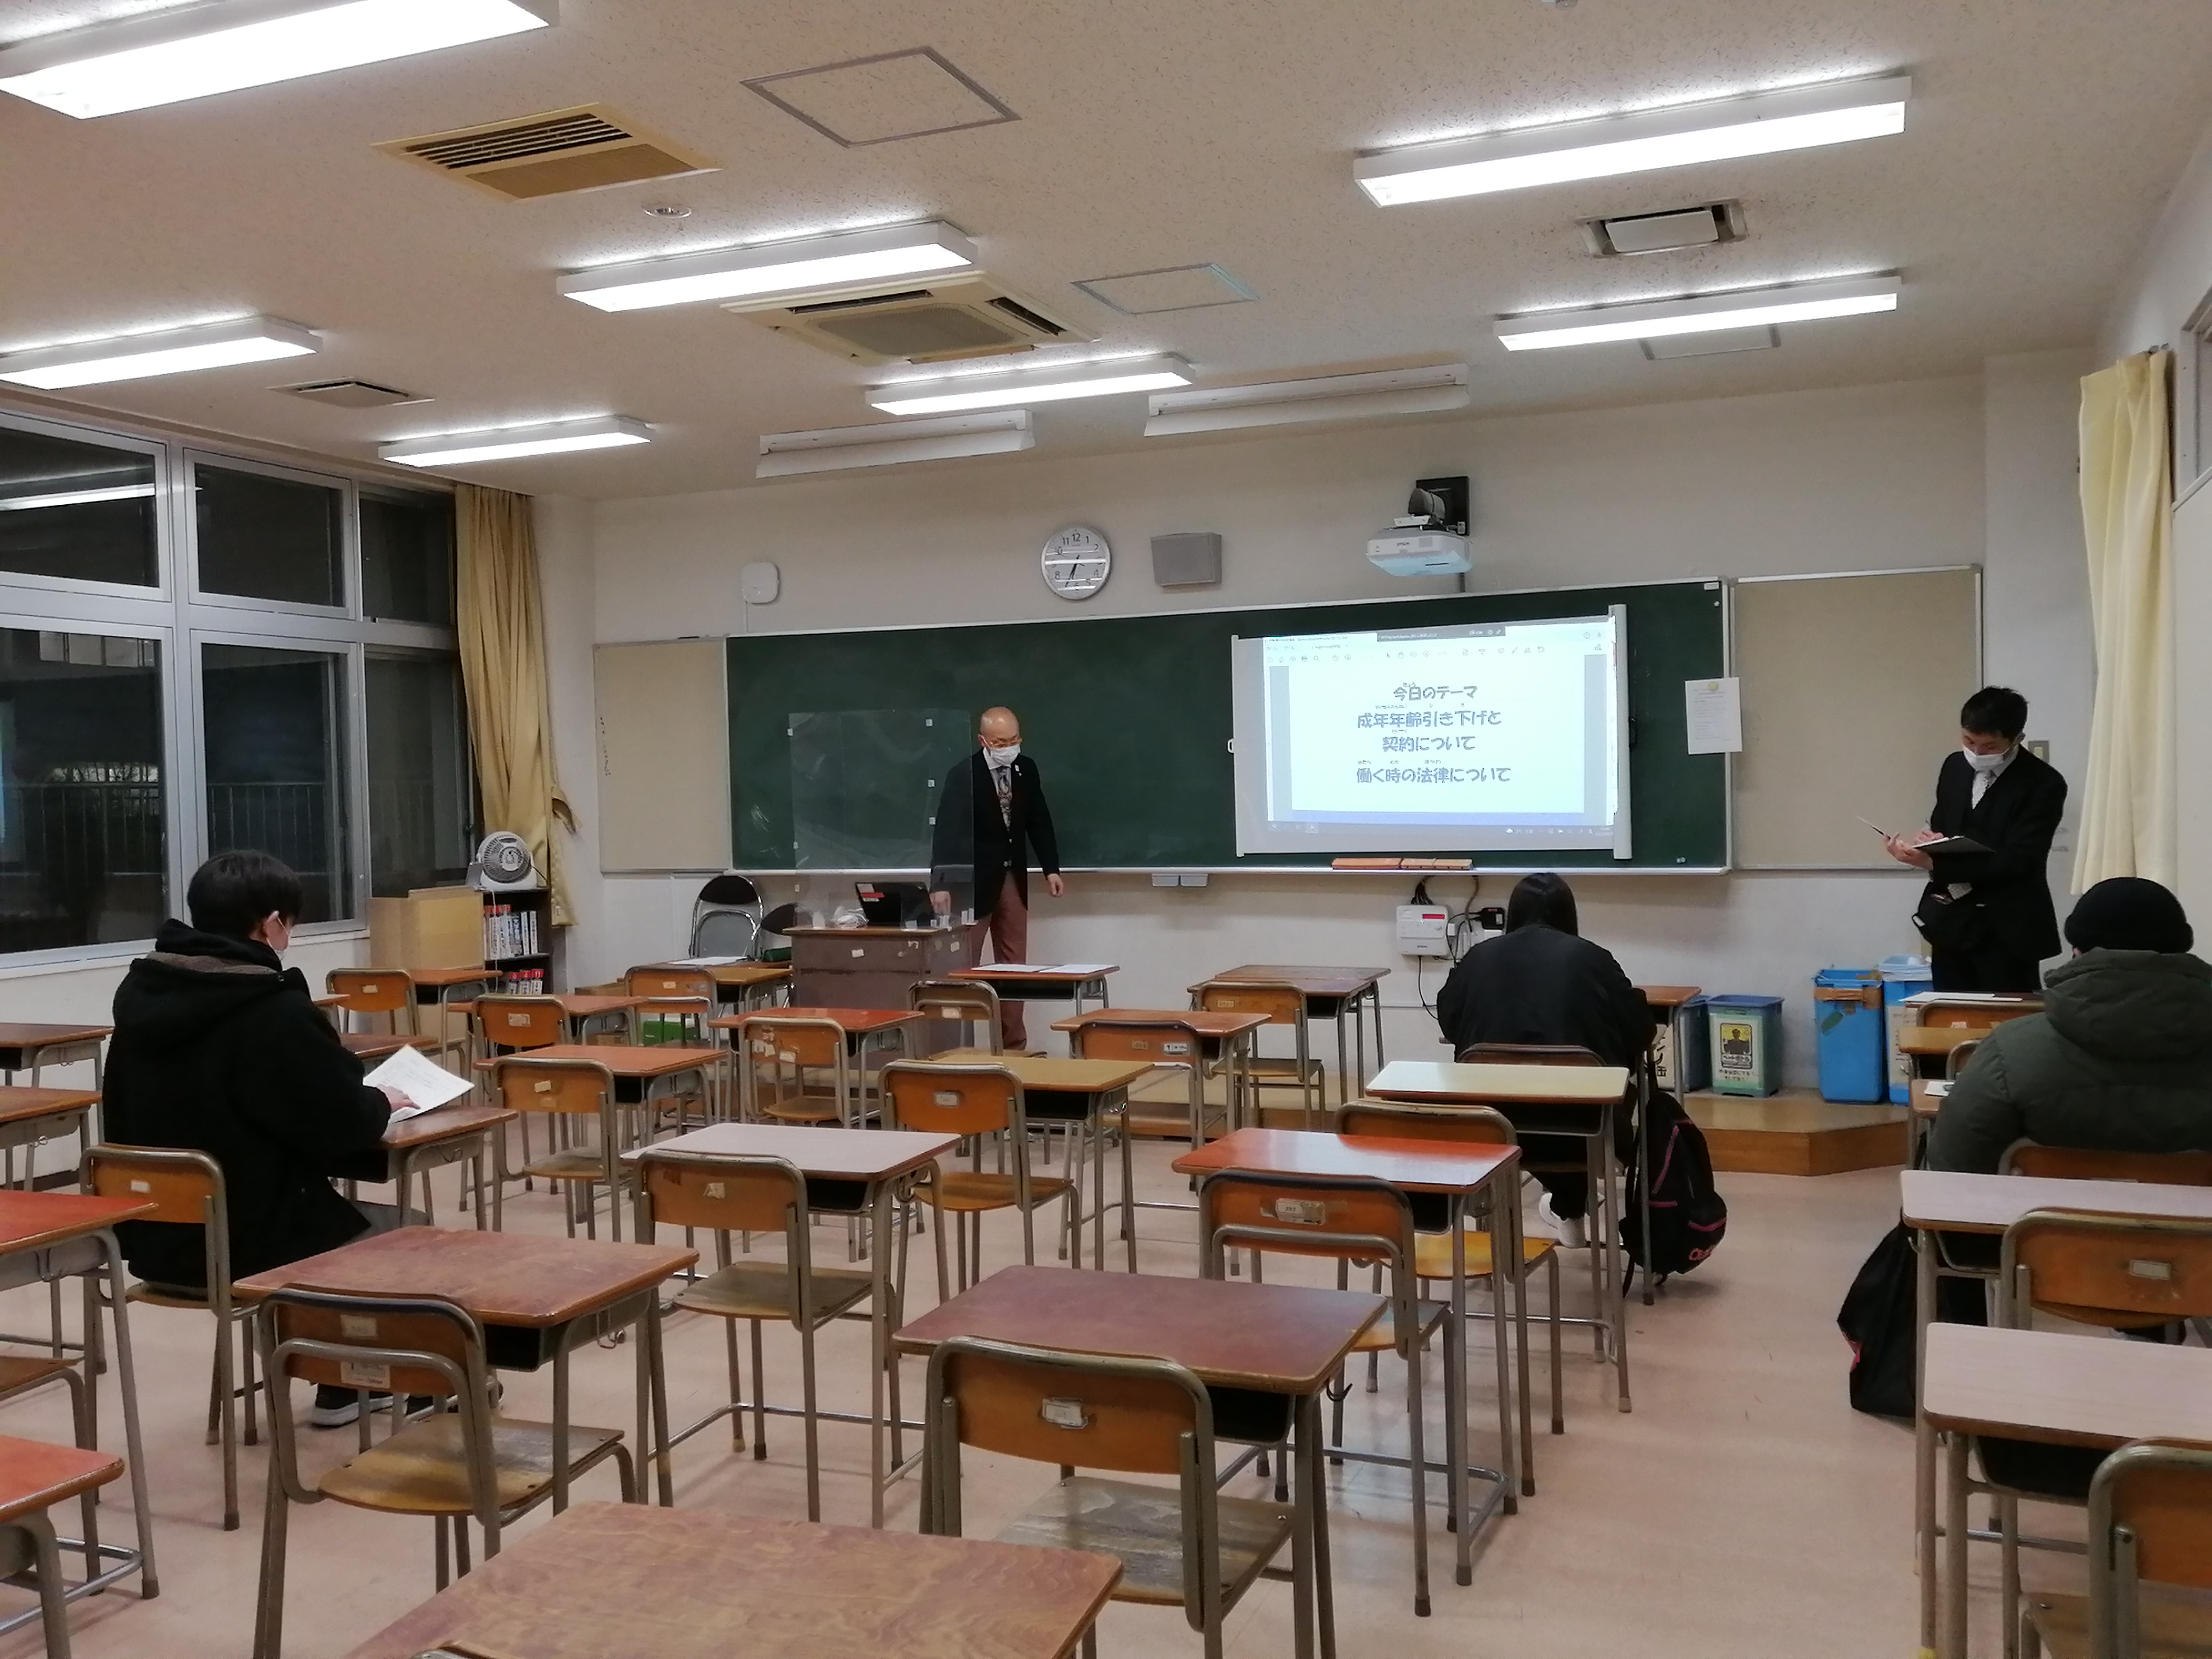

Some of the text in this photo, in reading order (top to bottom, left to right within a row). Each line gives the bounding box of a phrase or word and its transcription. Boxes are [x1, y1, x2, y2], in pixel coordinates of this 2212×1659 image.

[1072, 533, 1080, 542] 12
[1055, 571, 1060, 579] 8
[1393, 686, 1478, 701] 今日のテーマ
[1357, 710, 1502, 728] 成年年齢引き下げと
[1382, 736, 1476, 752] 契約について
[1357, 767, 1511, 783] 働く時の法律について
